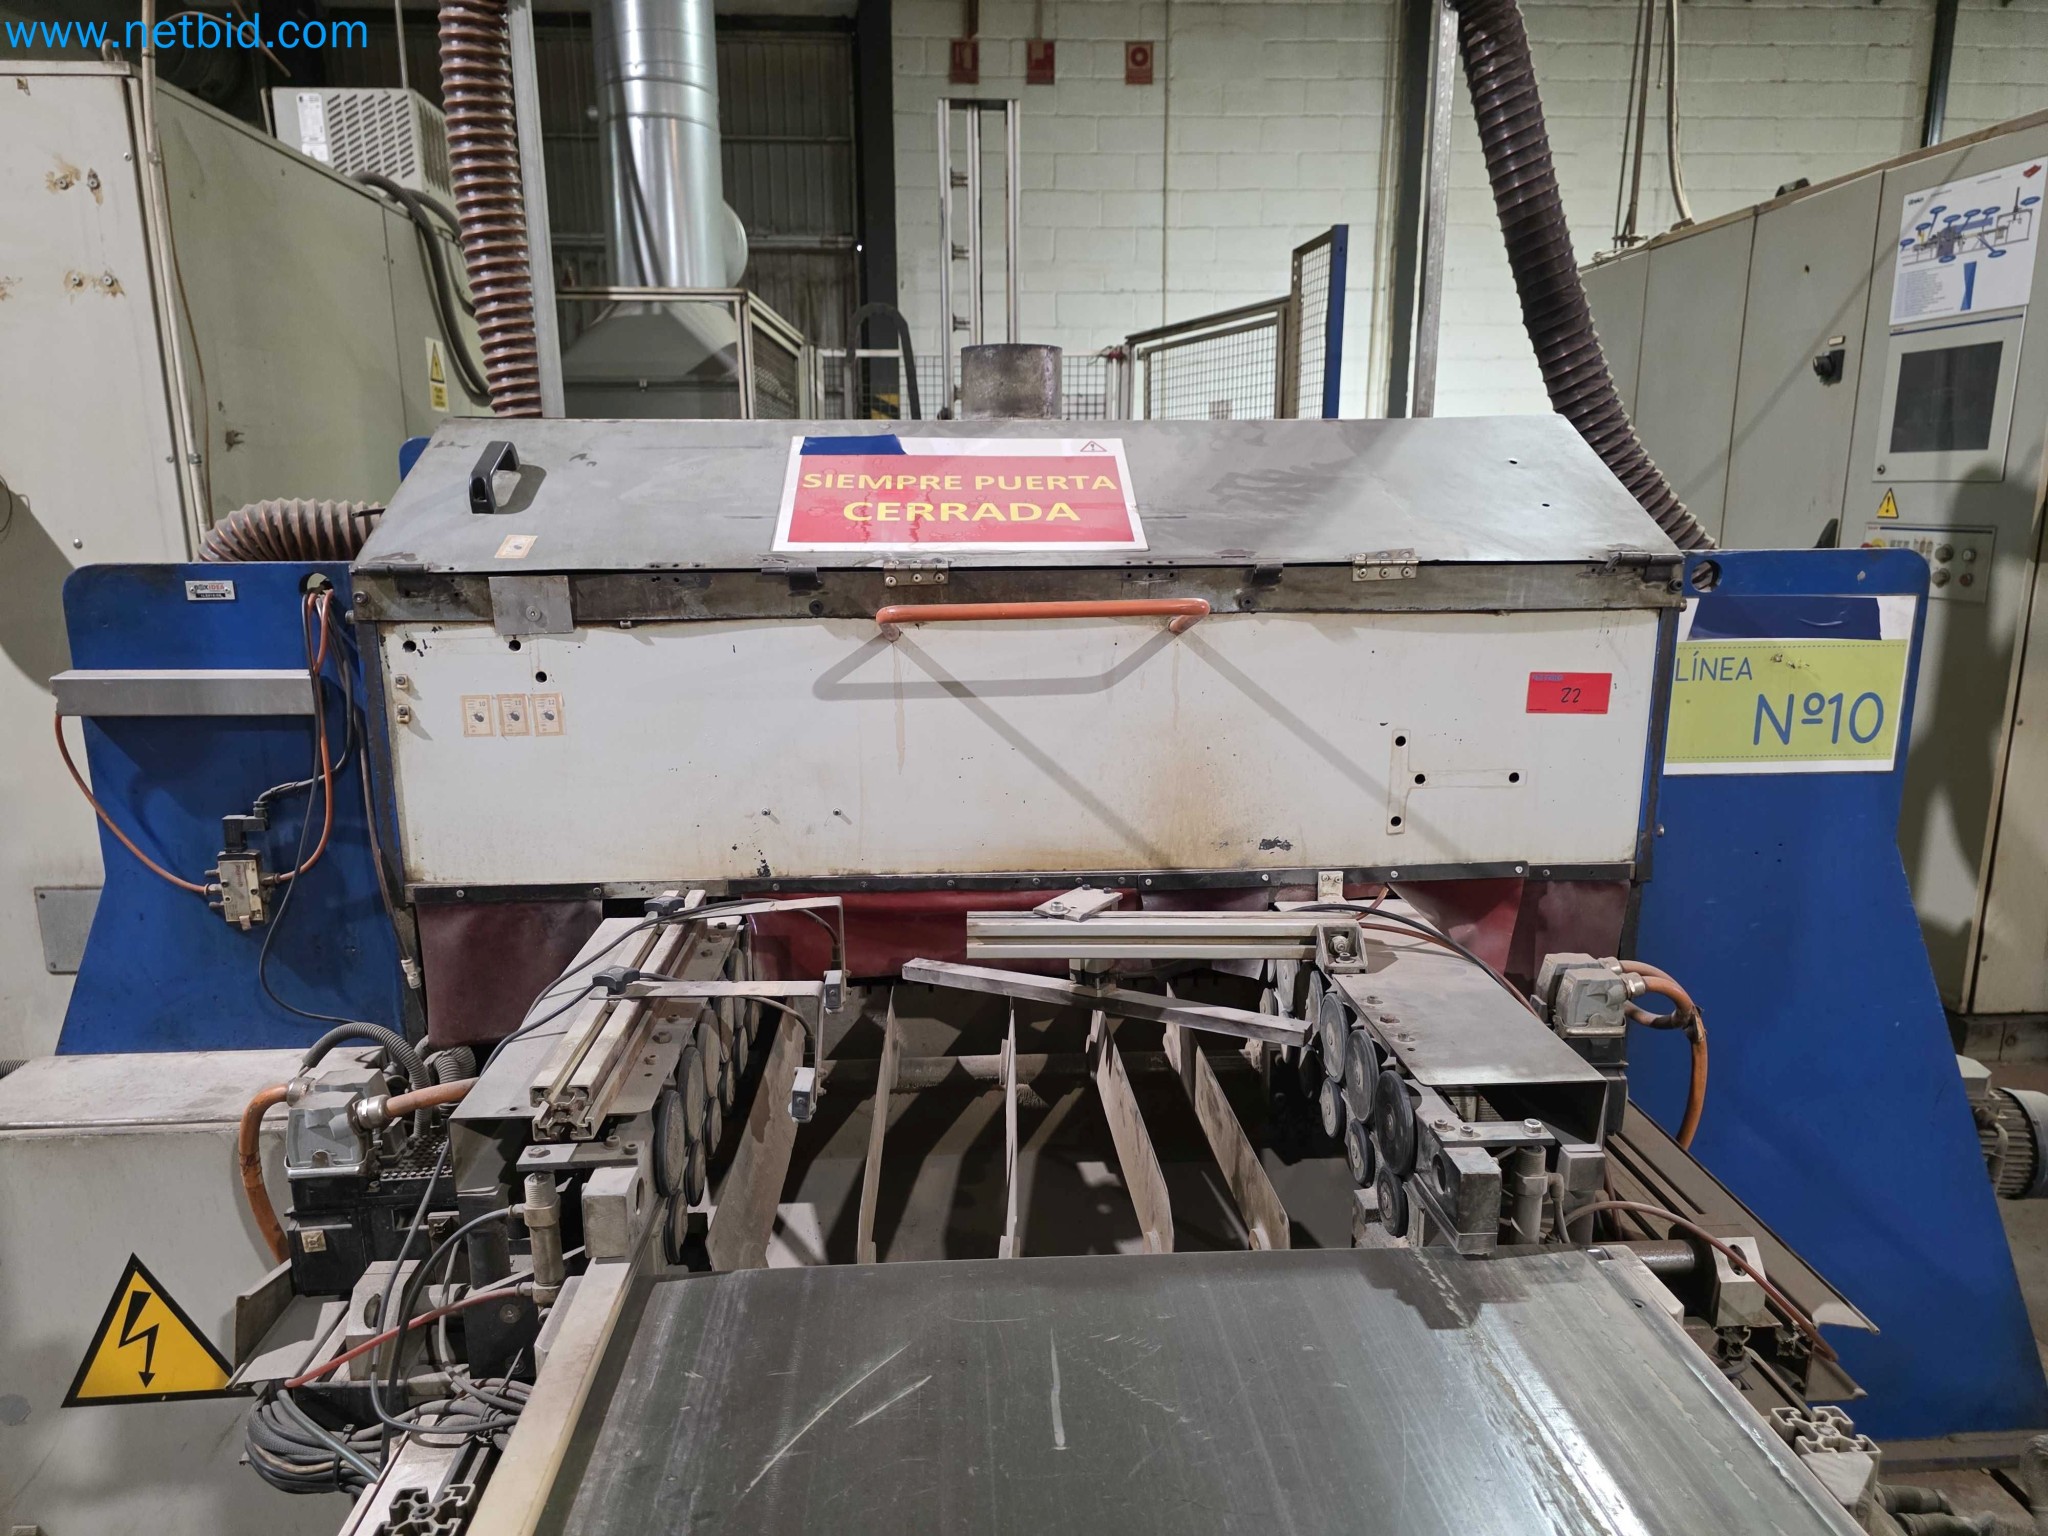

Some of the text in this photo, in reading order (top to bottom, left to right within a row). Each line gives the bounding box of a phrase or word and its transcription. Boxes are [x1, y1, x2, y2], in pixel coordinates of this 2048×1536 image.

[802, 473, 1118, 491] SIEMPRE PUERTA
[843, 502, 1081, 523] CERRADA
[1674, 651, 1752, 682] LÍNEA
[1560, 687, 1581, 704] 22
[1753, 692, 1884, 745] Nº10
